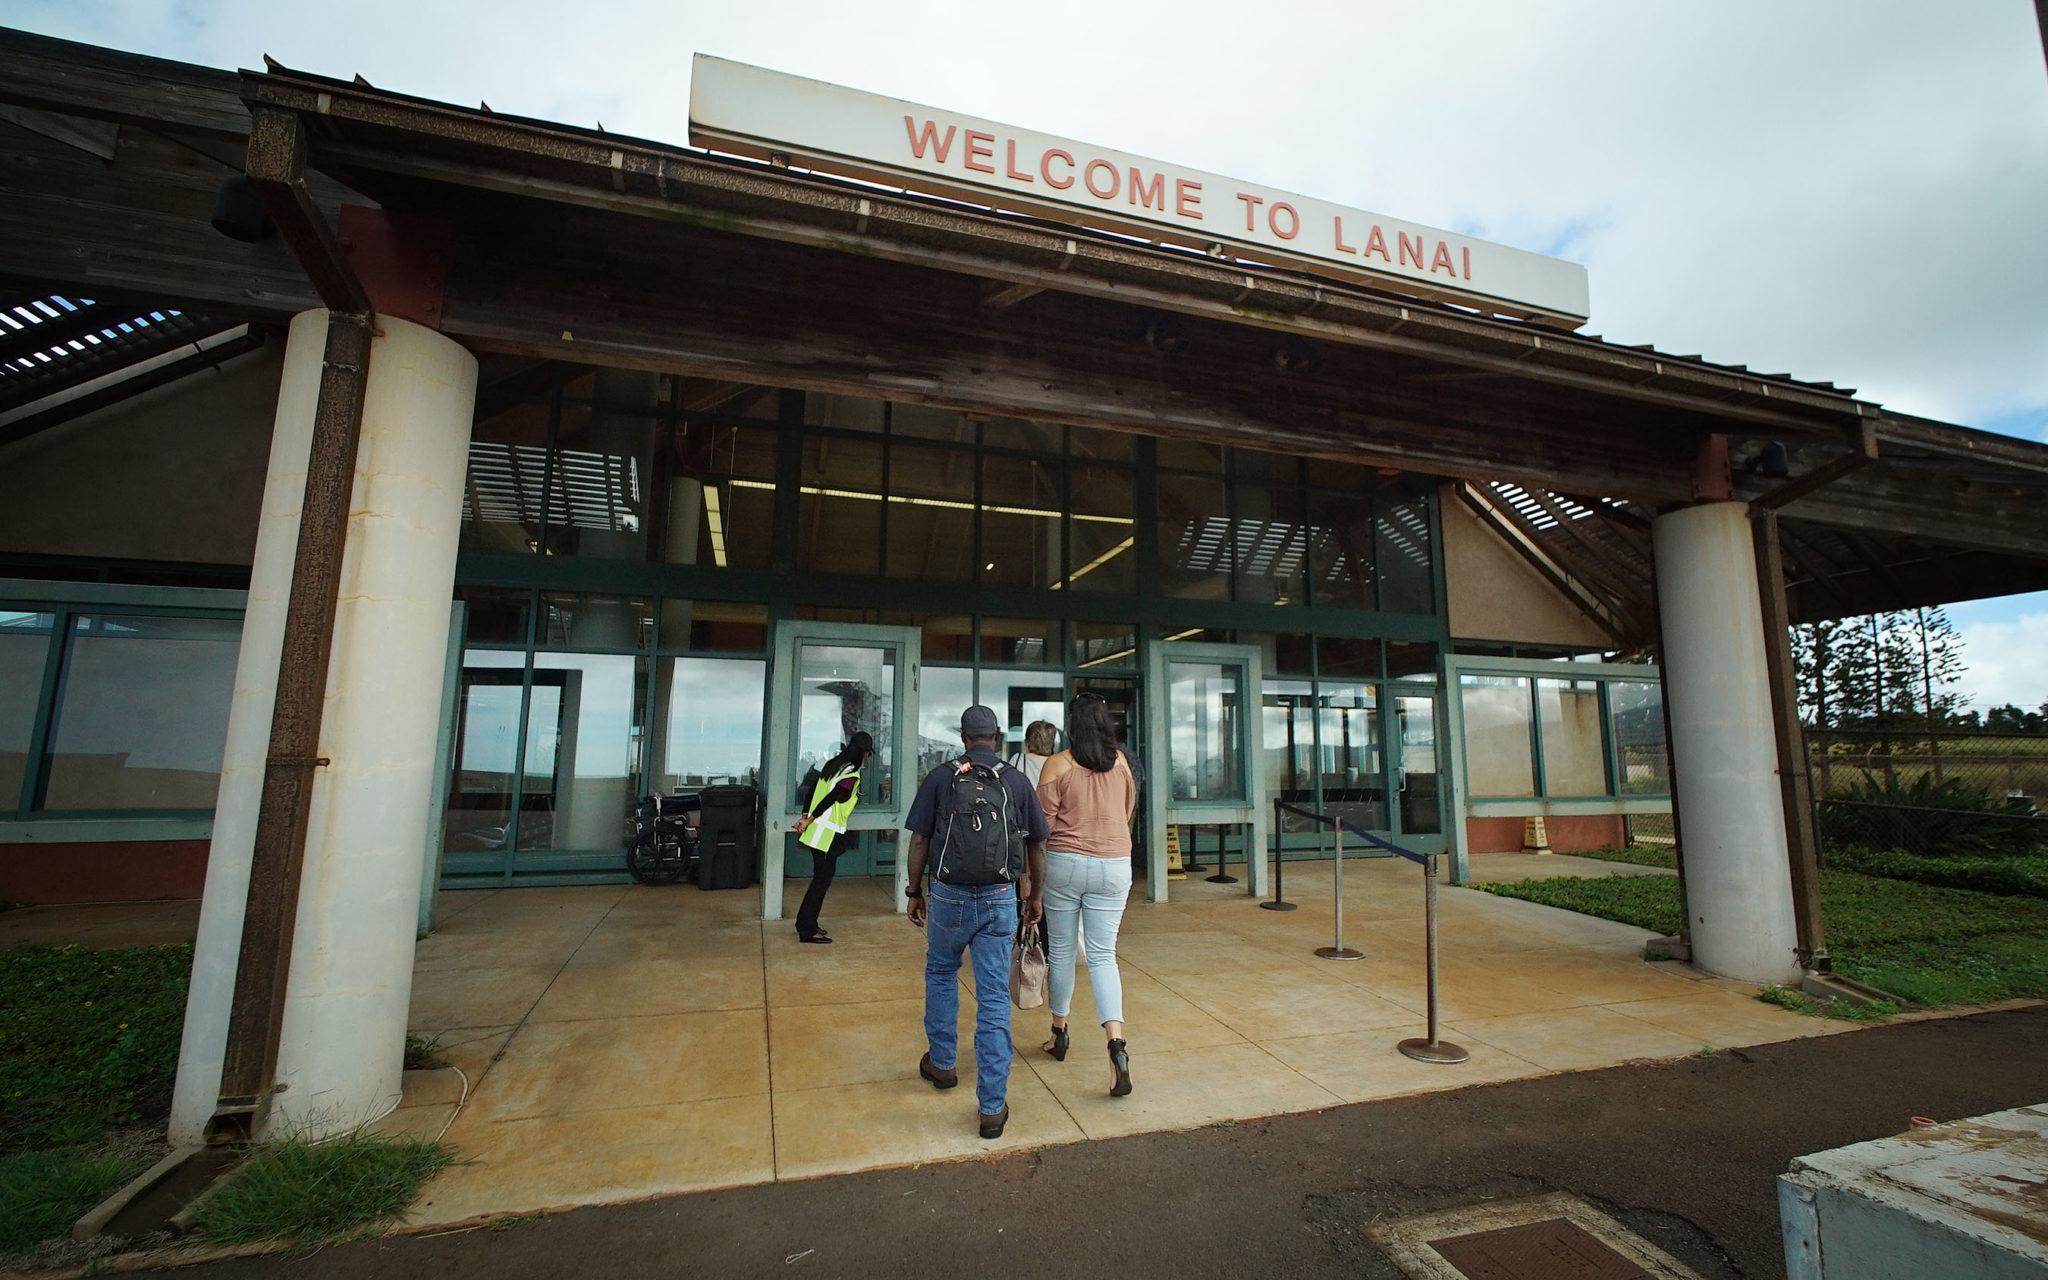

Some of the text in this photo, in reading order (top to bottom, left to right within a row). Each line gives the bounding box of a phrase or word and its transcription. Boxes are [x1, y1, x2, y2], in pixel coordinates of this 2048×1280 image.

[905, 116, 1471, 281] WELCOME TO LANAI
